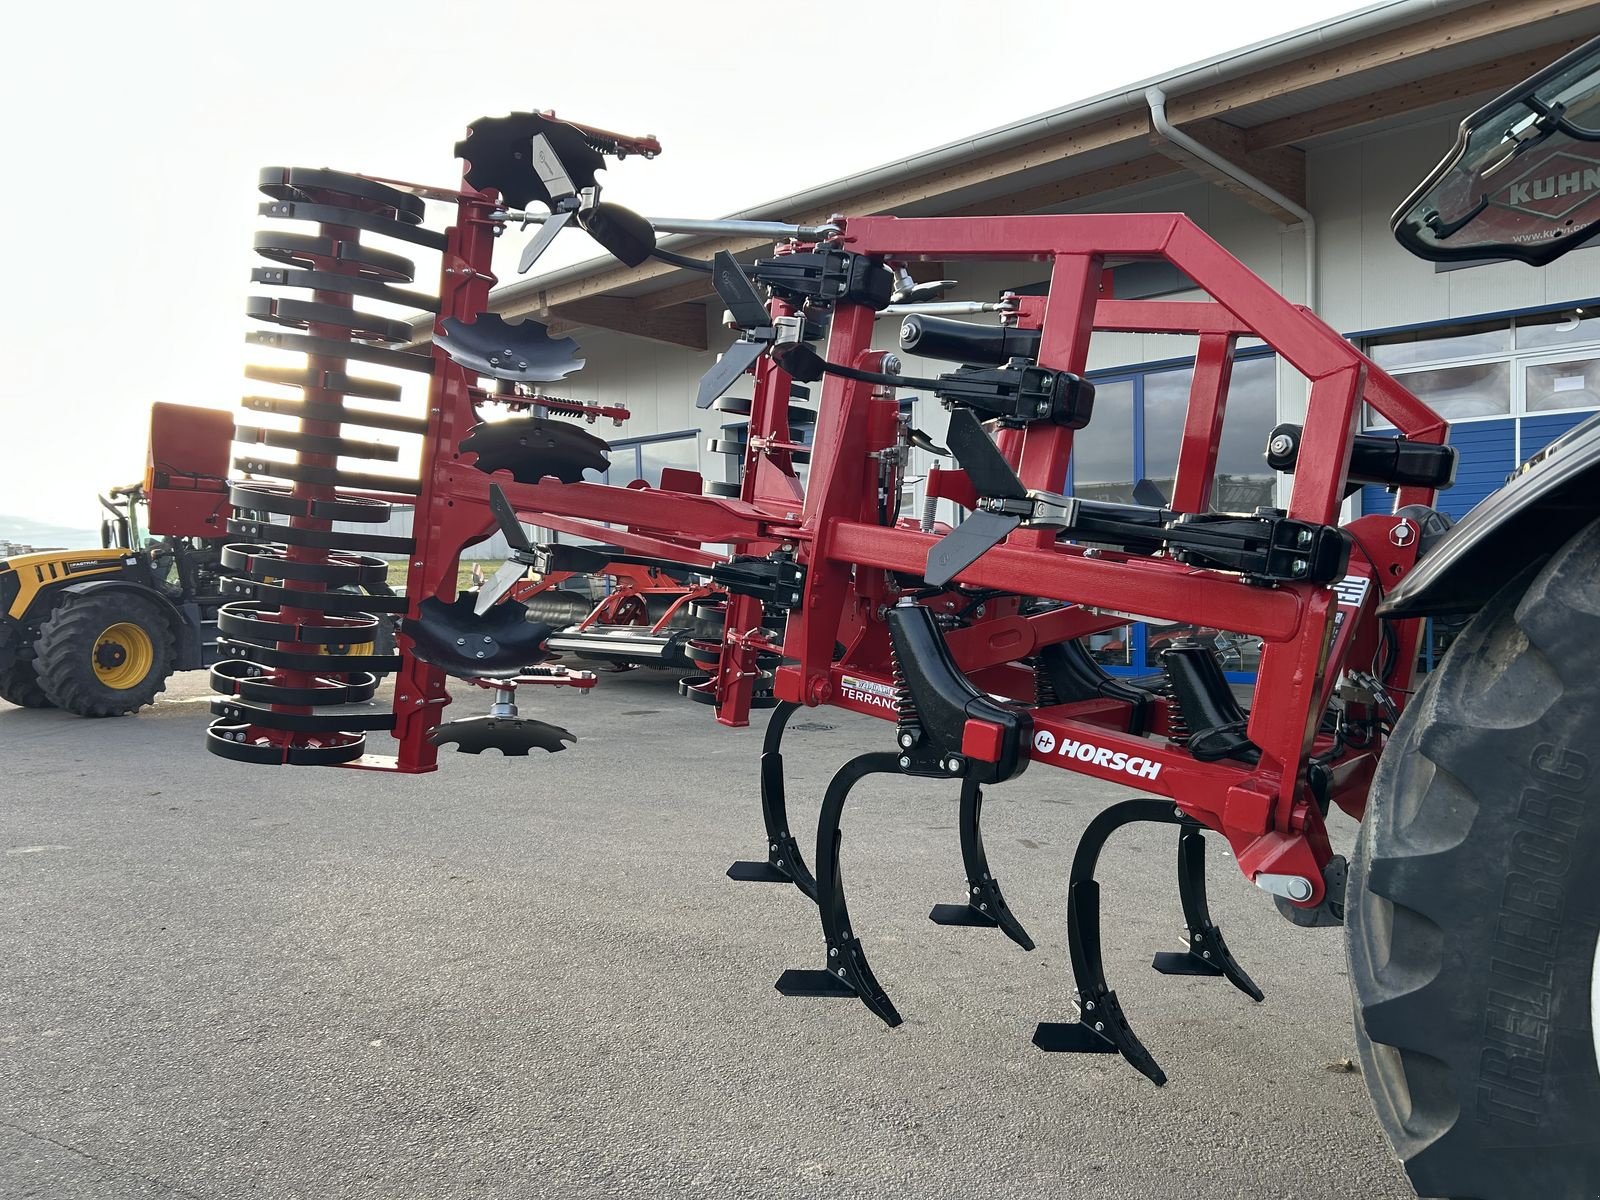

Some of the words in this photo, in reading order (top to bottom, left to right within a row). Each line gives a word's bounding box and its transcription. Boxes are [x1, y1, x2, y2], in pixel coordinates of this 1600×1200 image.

[1510, 167, 1600, 205] KUHN
[1058, 738, 1162, 780] HORSCH
[1476, 741, 1593, 1128] TRELLEBORG
